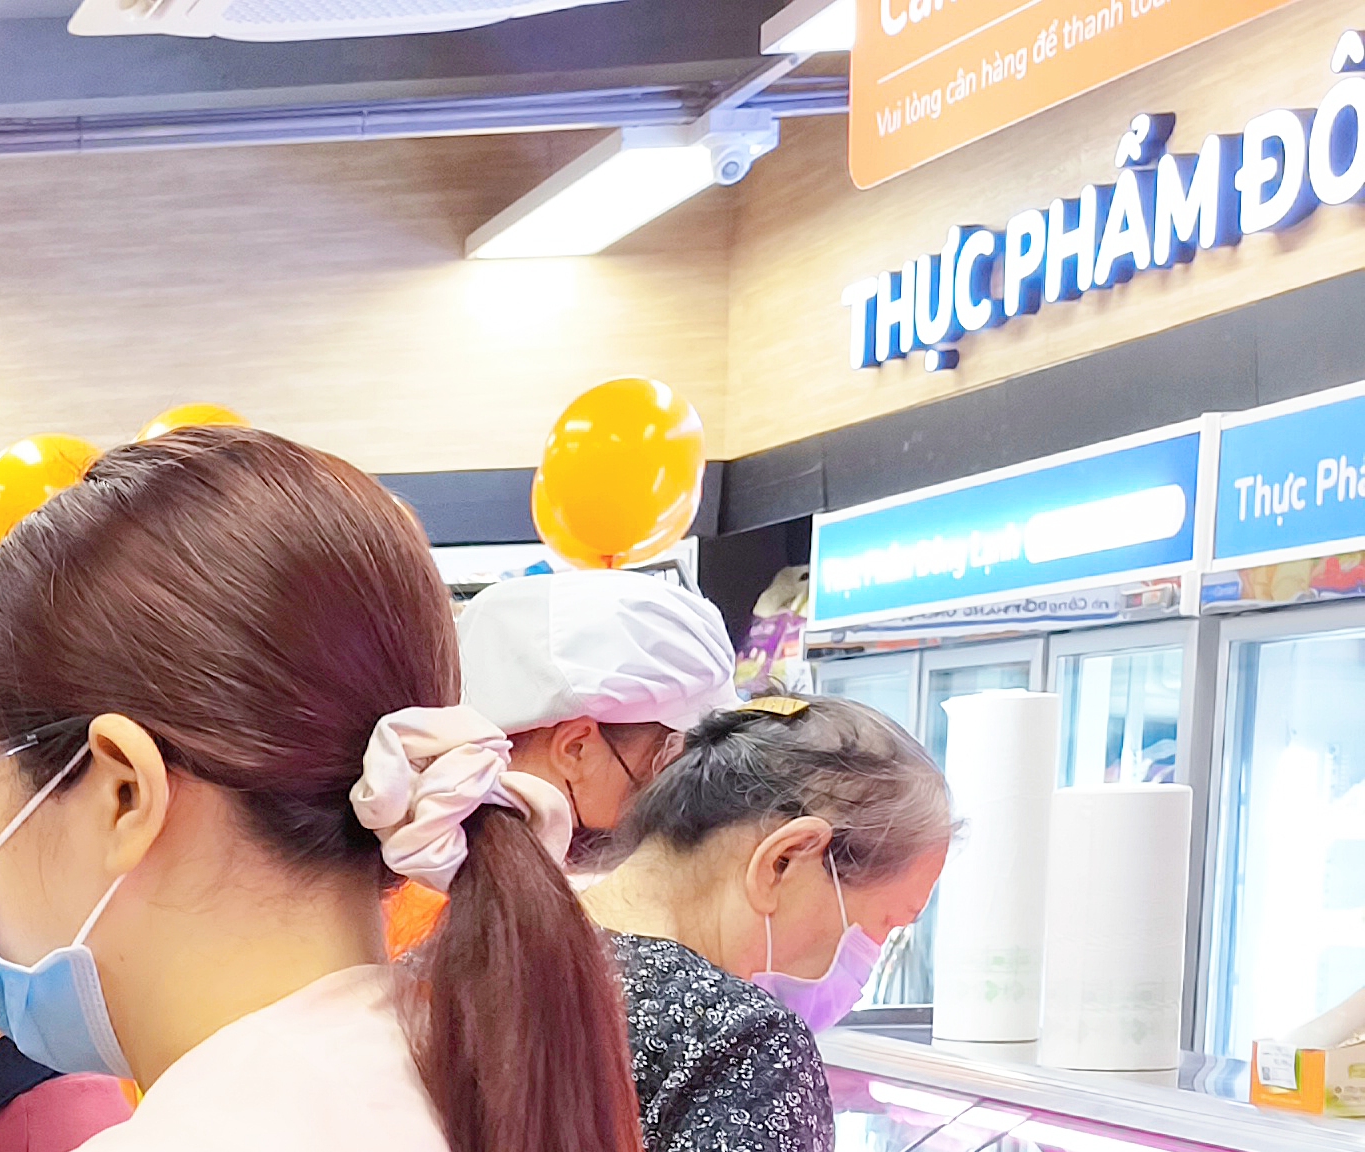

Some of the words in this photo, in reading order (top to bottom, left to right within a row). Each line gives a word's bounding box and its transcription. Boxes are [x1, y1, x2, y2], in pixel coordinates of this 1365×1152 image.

[876, 109, 901, 138] Vui
[905, 87, 942, 120] lòng
[946, 70, 976, 105] cân
[980, 51, 1028, 88] hàng
[1032, 18, 1060, 64] để
[1063, 2, 1124, 50] thanh
[840, 224, 999, 373] THỰC
[1003, 112, 1227, 320] PHẨM
[1234, 471, 1307, 527] Thực
